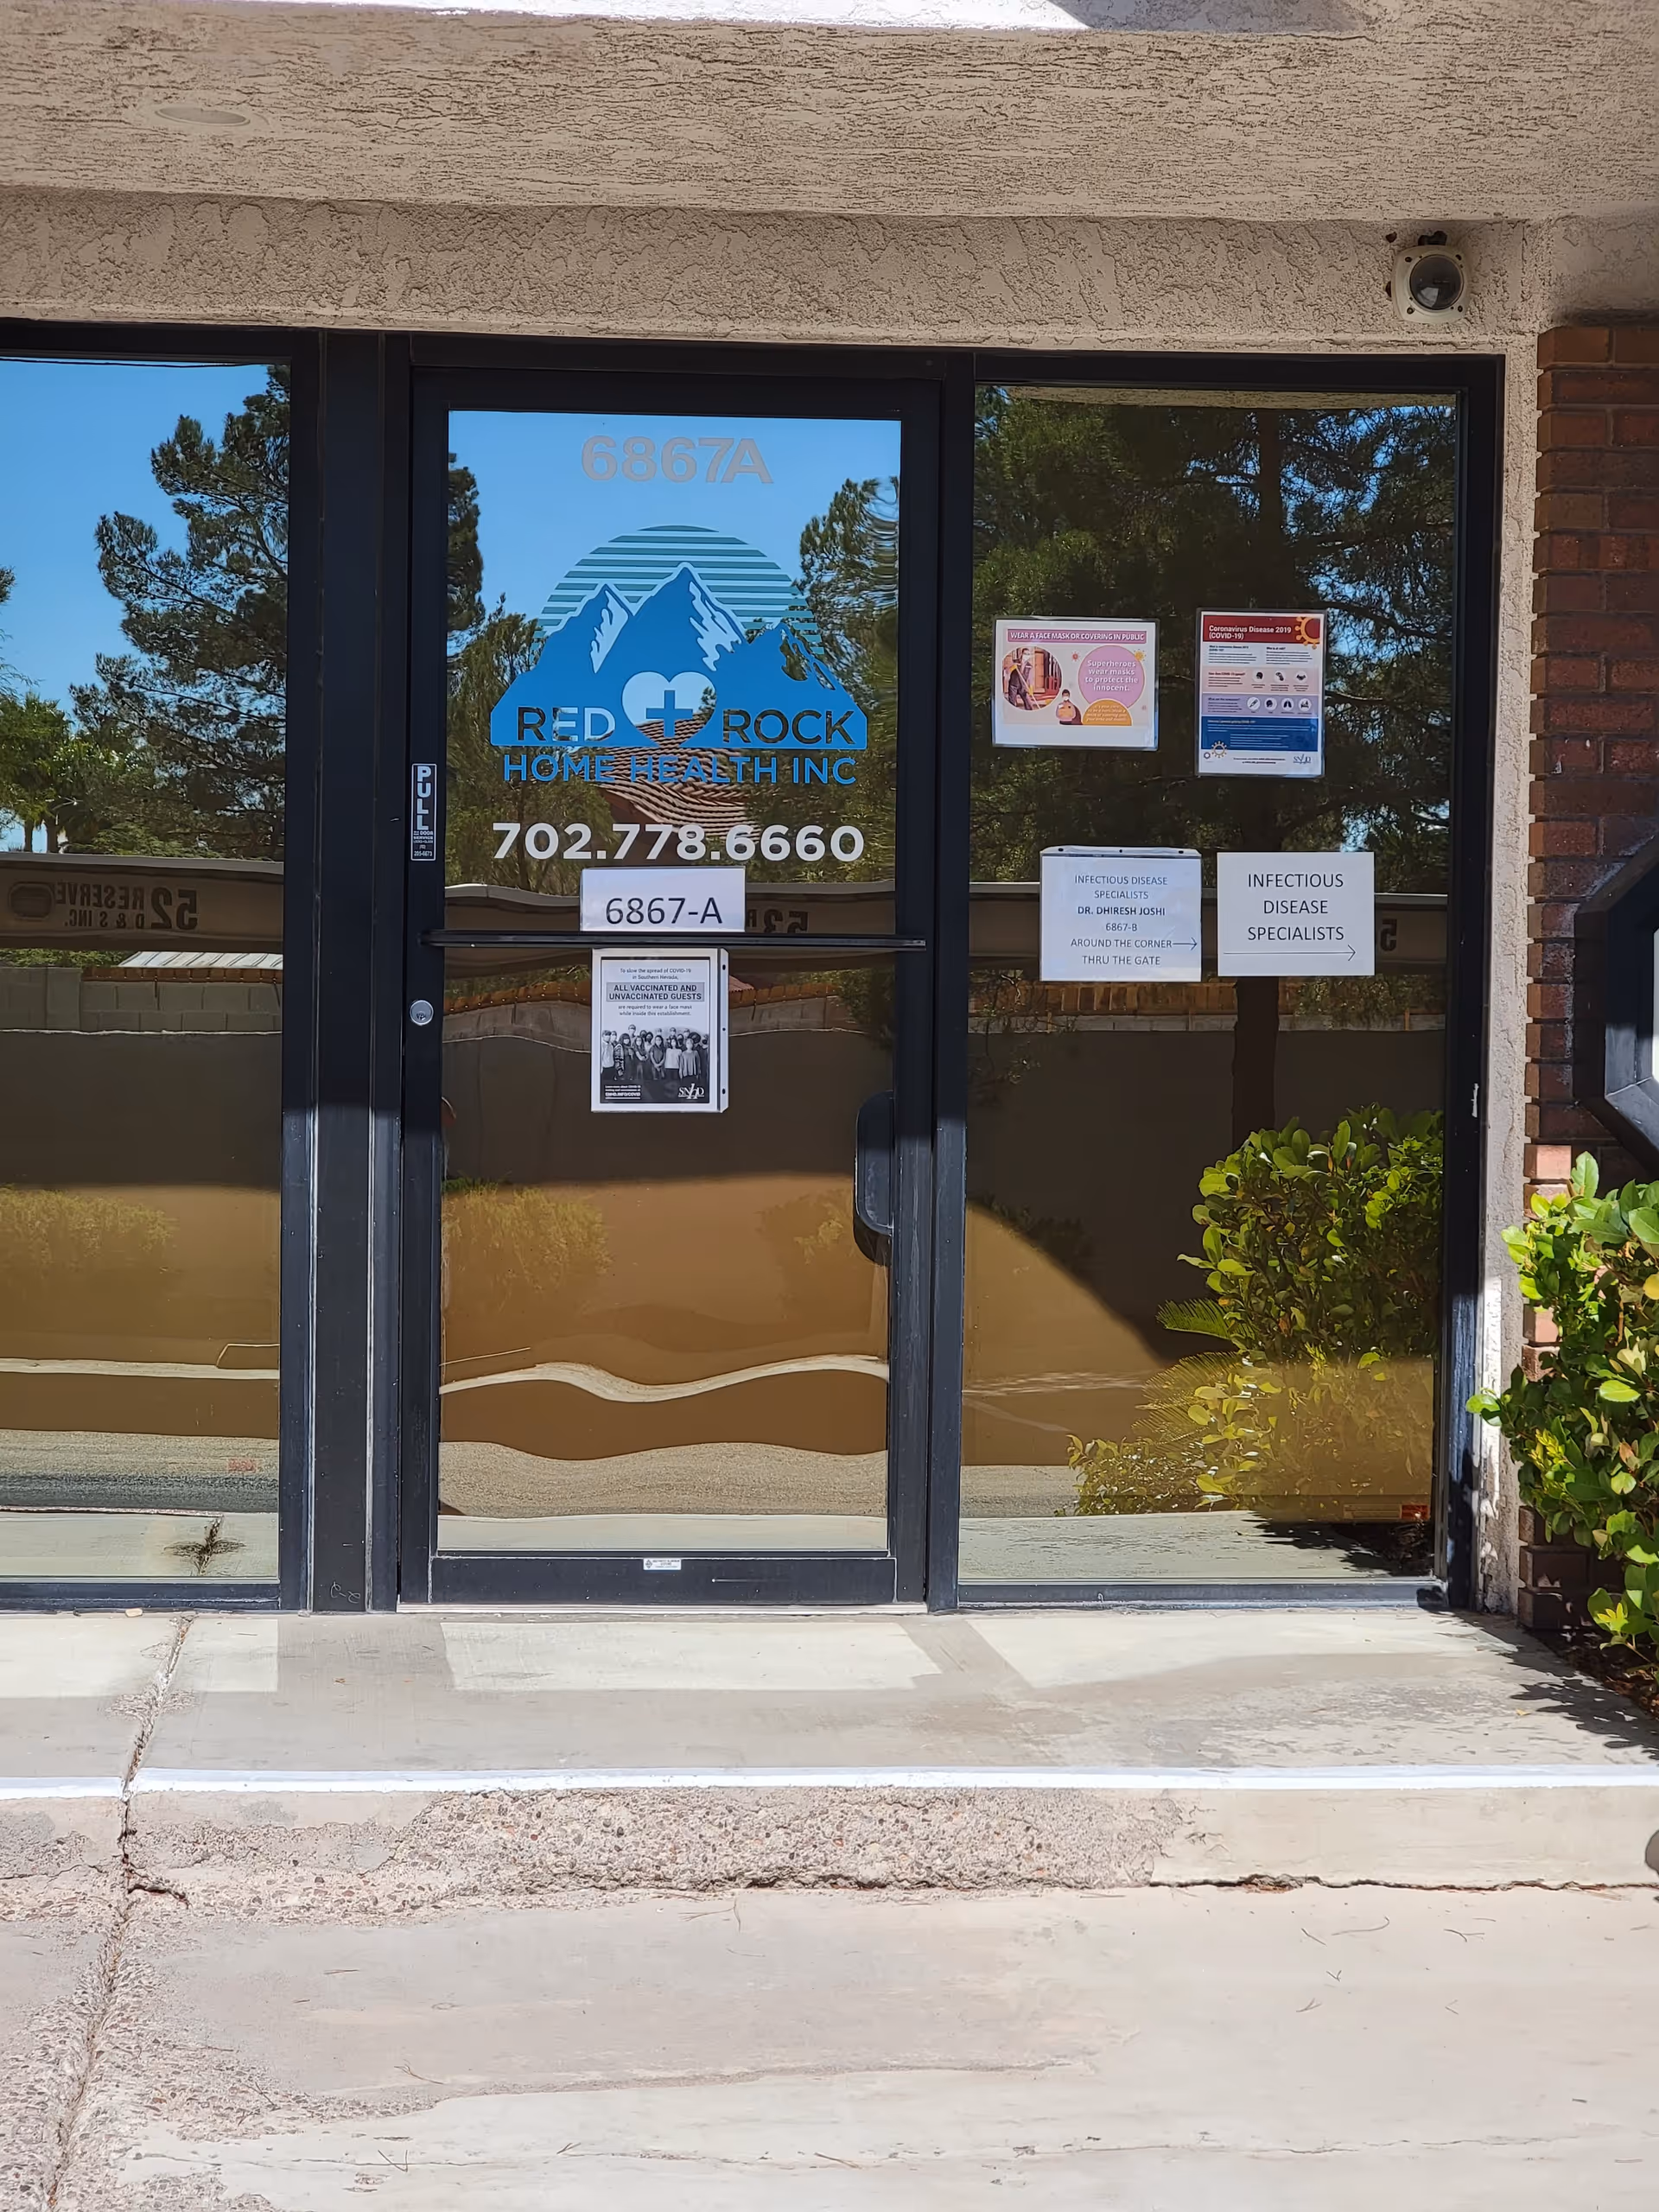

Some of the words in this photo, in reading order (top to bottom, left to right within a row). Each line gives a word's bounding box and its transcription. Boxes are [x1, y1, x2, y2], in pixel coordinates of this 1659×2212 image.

[582, 435, 774, 484] 6867A
[518, 707, 616, 742] RED
[722, 709, 855, 745] ROCK
[504, 754, 614, 783] HOME
[630, 756, 777, 784] HEALTH
[792, 757, 856, 785] INC
[416, 766, 431, 830] PULL
[493, 822, 864, 862] 702.778.6660
[1075, 875, 1129, 885] INFECTIOUS
[1131, 876, 1168, 886] DISEASE
[1248, 874, 1344, 888] INFECTIOUS
[1094, 890, 1148, 899] SPECIALISTS
[606, 897, 722, 925] 6867-A
[1077, 906, 1094, 915] DR.
[1096, 906, 1137, 915] DHIRESH
[1138, 907, 1166, 916] JOSHI
[1263, 899, 1329, 914] DISEASE
[1105, 923, 1138, 931] 6867-B
[1248, 926, 1344, 941] SPECIALISTS
[1071, 938, 1112, 948] AROUND
[1115, 939, 1132, 948] THE
[1134, 939, 1173, 949] CORNER
[1082, 956, 1109, 965] THRU
[1112, 956, 1132, 965] THE
[1135, 956, 1161, 966] GATE
